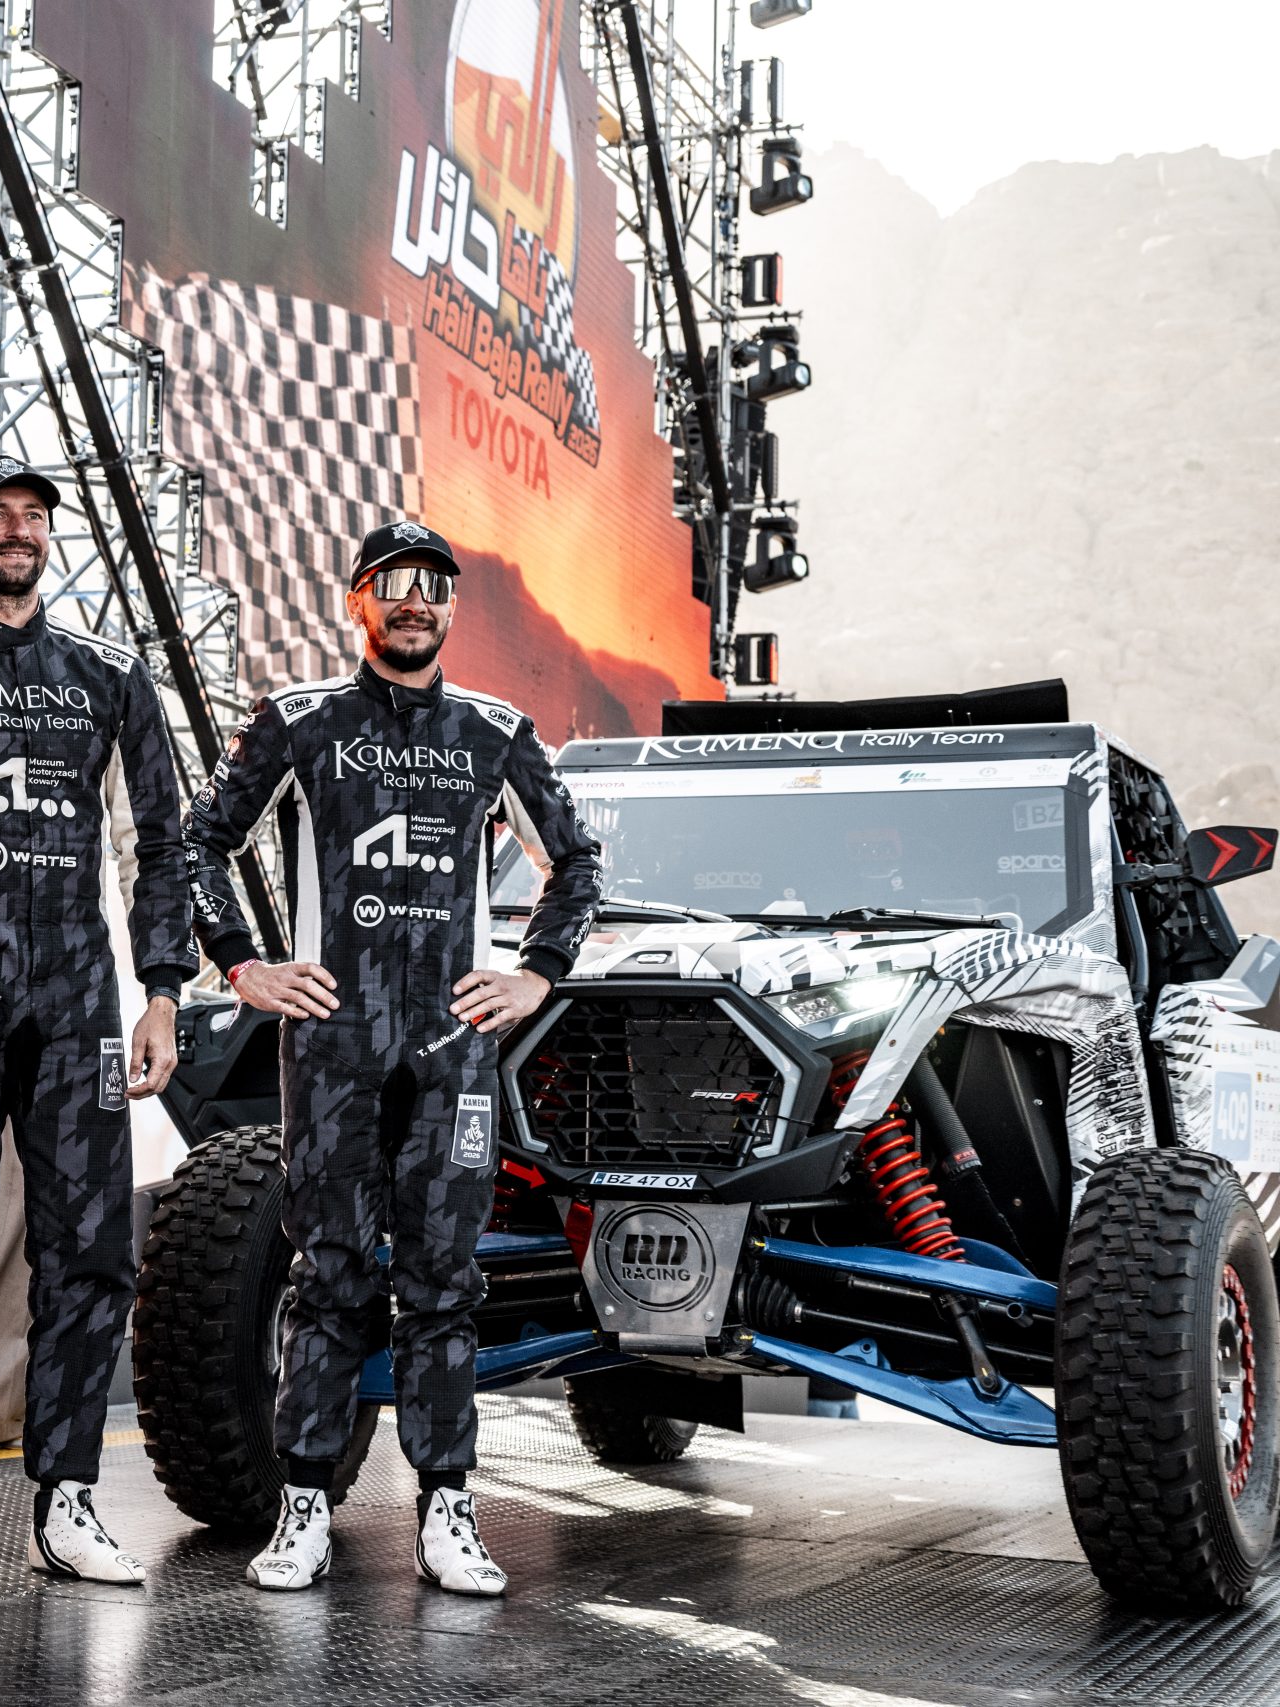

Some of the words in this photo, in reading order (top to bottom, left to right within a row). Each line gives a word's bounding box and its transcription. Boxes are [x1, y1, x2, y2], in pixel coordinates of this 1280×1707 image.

[423, 266, 476, 358] Hail
[473, 308, 522, 399] Baja
[521, 348, 574, 440] Rally
[447, 371, 550, 500] TOYOTA
[285, 698, 312, 713] OMP
[45, 714, 94, 732] Team
[489, 710, 514, 725] OMP
[860, 732, 924, 748] Rally
[931, 731, 1004, 746] Team
[383, 772, 426, 790] Rally
[429, 774, 474, 792] Team
[411, 815, 446, 824] Muzeum
[410, 833, 440, 843] Kowary
[411, 824, 456, 836] Motoryzacji
[11, 851, 77, 867] WATIS
[388, 905, 451, 921] WATIS
[416, 1048, 428, 1058] T.
[462, 1097, 489, 1108] KAMENA
[1217, 1090, 1249, 1141] 409
[460, 1138, 485, 1152] DAKAR
[606, 1174, 633, 1185] BZ
[637, 1176, 660, 1186] 47
[664, 1176, 695, 1188] OX
[621, 1234, 689, 1266] RD
[621, 1266, 691, 1282] RACING
